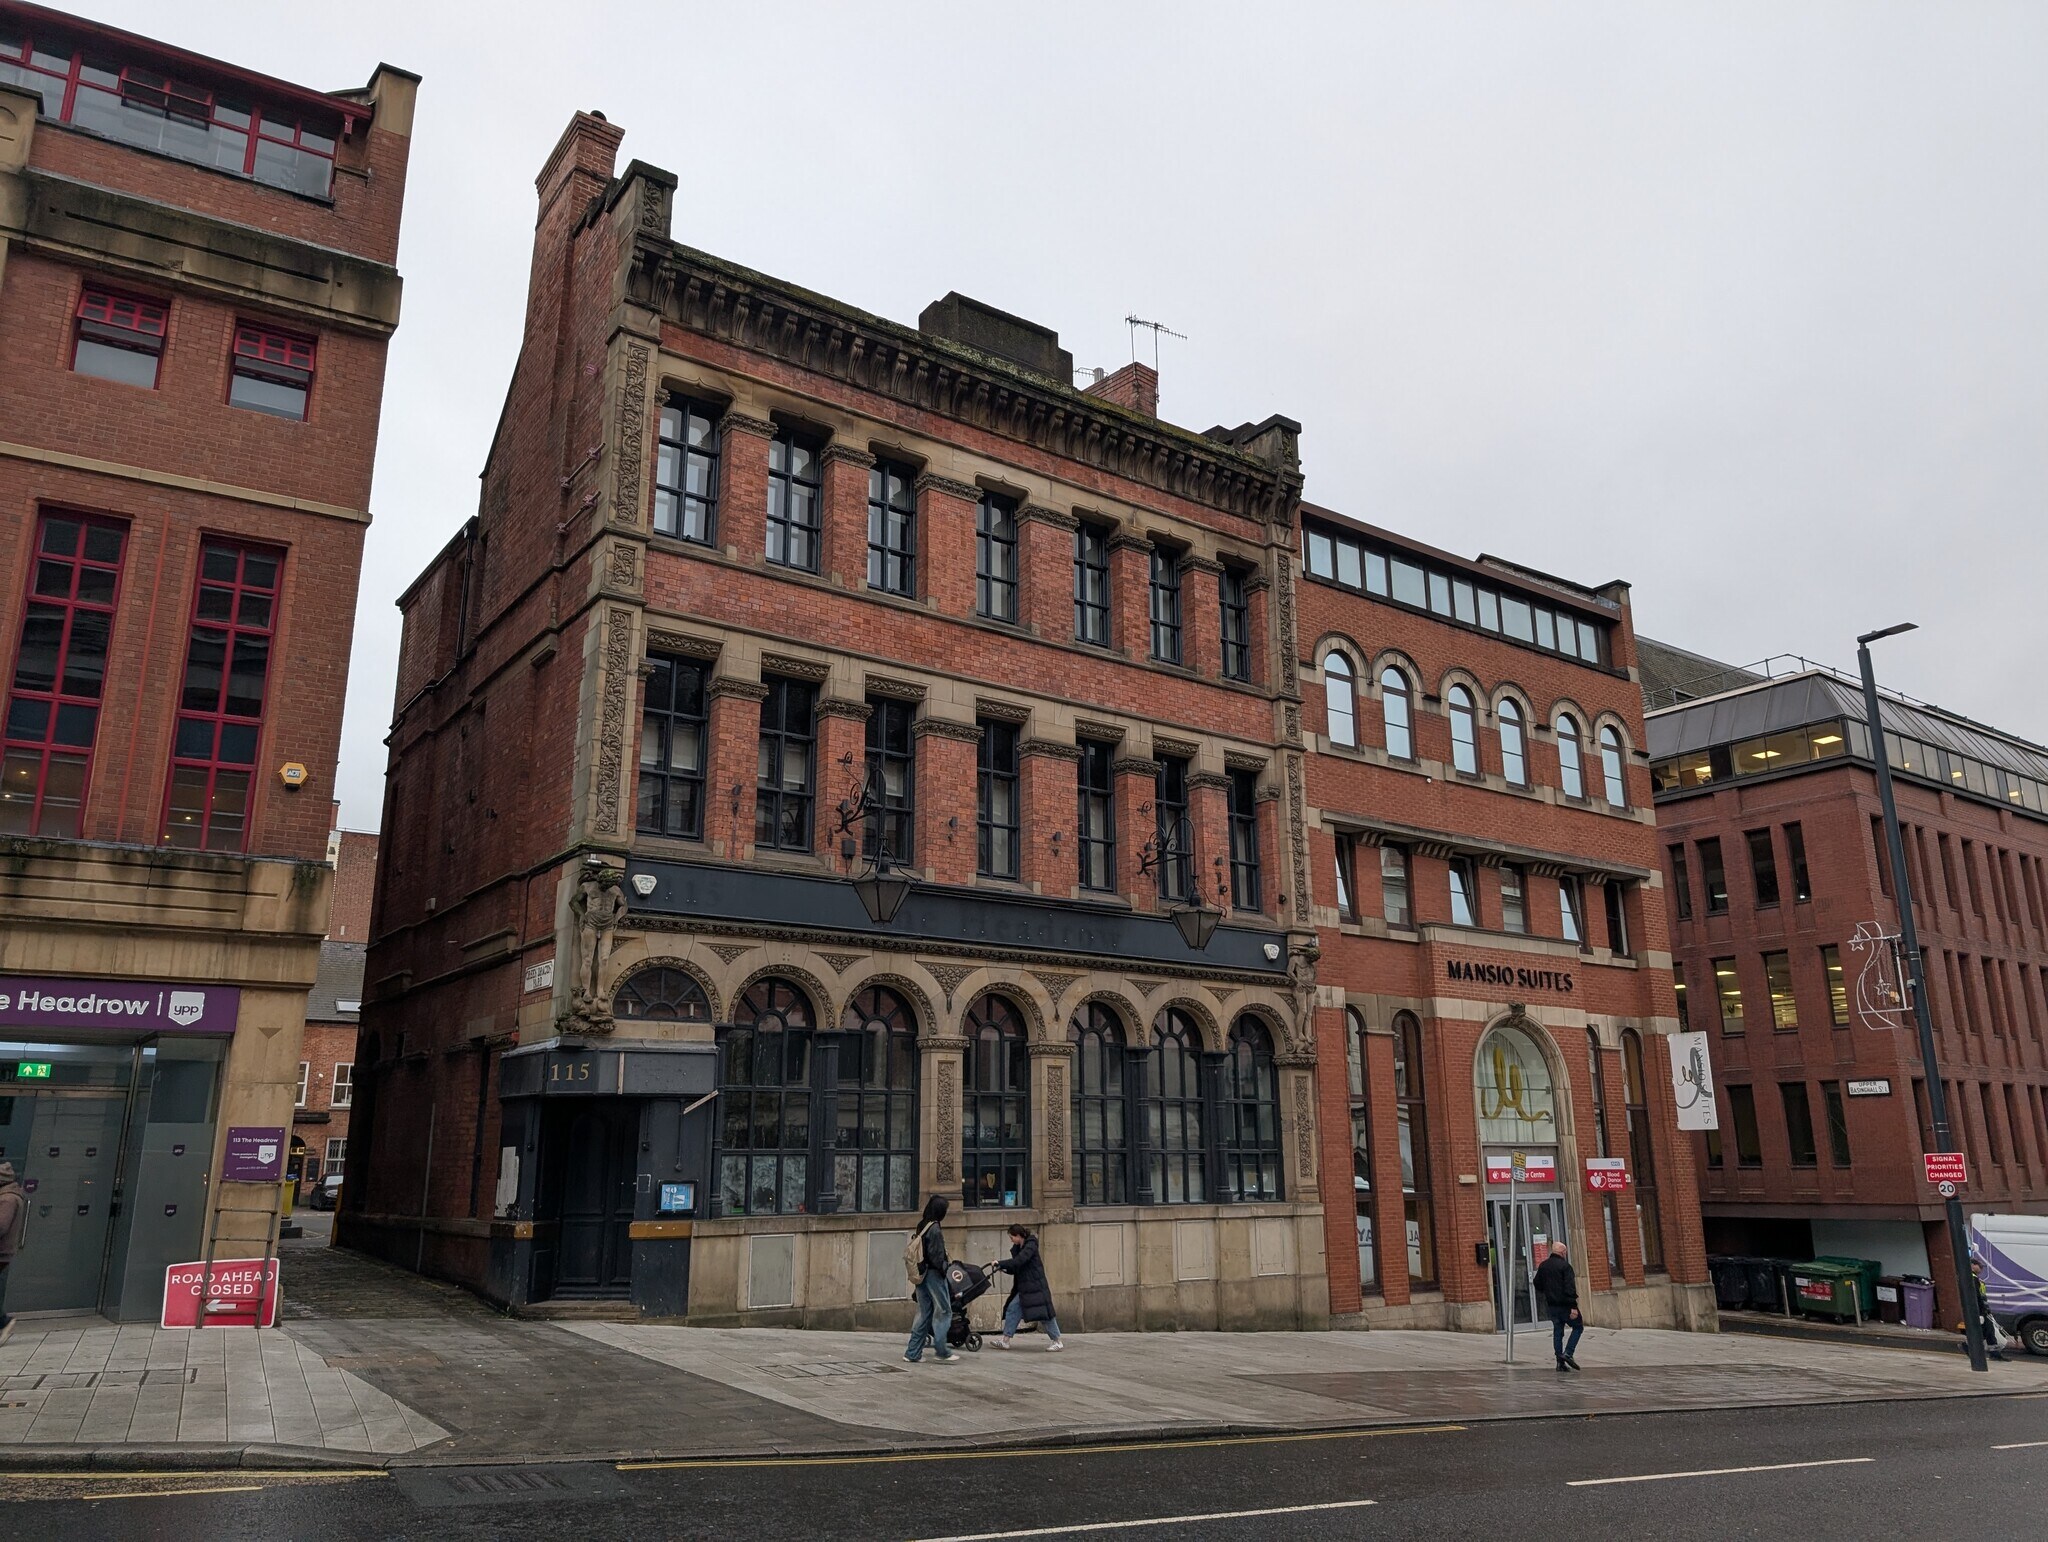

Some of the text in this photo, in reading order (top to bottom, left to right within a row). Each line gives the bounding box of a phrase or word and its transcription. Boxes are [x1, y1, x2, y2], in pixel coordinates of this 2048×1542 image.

[1447, 960, 1573, 991] MANSIO SUITES
[18, 991, 149, 1015] Headrow
[174, 1005, 199, 1016] ypp
[551, 1062, 590, 1081] 115
[1530, 1170, 1546, 1178] Centre
[1940, 1184, 1954, 1193] 20
[171, 1271, 274, 1284] ROAD AHEAD
[191, 1284, 253, 1296] COSED
